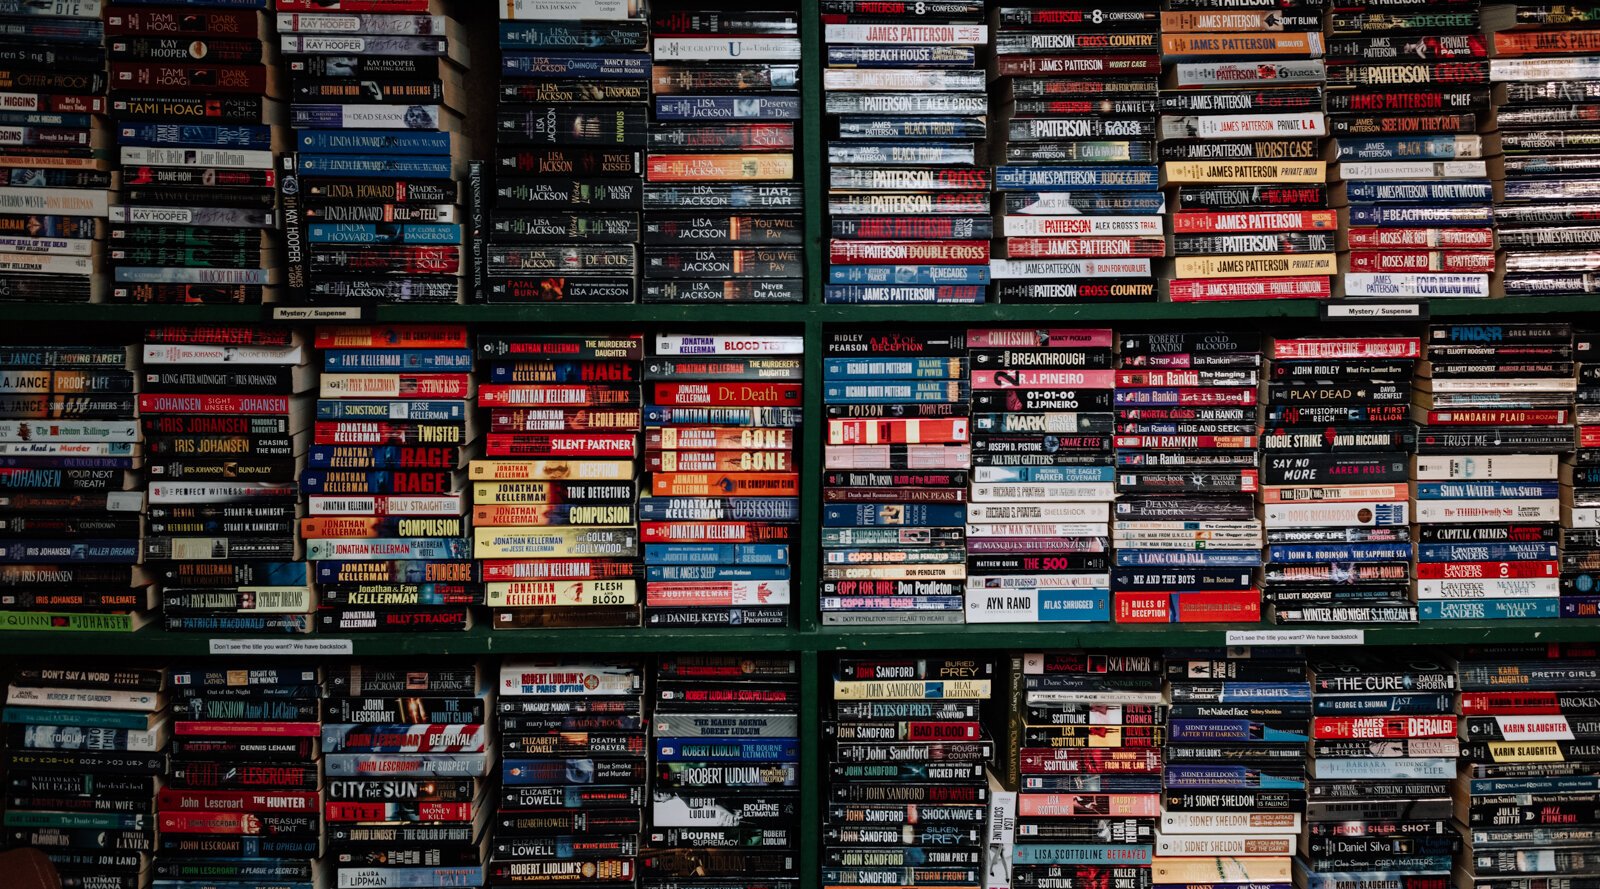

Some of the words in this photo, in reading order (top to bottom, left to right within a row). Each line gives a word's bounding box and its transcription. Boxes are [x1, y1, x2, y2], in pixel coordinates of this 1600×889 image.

[867, 27, 898, 41] JAMES
[900, 27, 954, 41] PATTERSON
[160, 40, 178, 48] KAY
[306, 41, 323, 49] KAY
[326, 41, 360, 50] HOOPER
[1190, 39, 1219, 50] JAMES
[1222, 38, 1276, 49] PATTERSON
[1441, 37, 1469, 48] PRIVATE
[151, 49, 188, 58] HOOPER
[1369, 67, 1430, 83] PATTERSON
[697, 99, 715, 107] LISA
[129, 103, 160, 114] TAMI
[164, 104, 203, 115] HOAG
[692, 106, 731, 117] JACKSON
[616, 111, 624, 142] ENVIOUS
[1256, 142, 1287, 157] WORST
[1289, 142, 1313, 156] CASE
[1207, 167, 1232, 178] JAMES
[1234, 166, 1277, 177] PATTERSON
[1281, 167, 1301, 175] PRIVATE
[1432, 185, 1485, 197] HONEYMOON
[133, 212, 150, 220] KAY
[152, 212, 188, 220] HOOPER
[286, 209, 298, 224] KAY
[327, 233, 374, 241] HOWARD
[287, 227, 301, 263] HOOPER
[862, 288, 889, 301] JAMES
[891, 288, 934, 300] PATTERSON
[1079, 285, 1109, 296] CROSS
[1111, 285, 1153, 296] COUNTRY
[1452, 326, 1502, 341] FINDER
[1012, 352, 1085, 364] BREAKTHROUGH
[1149, 373, 1164, 385] Ian
[1167, 372, 1198, 385] Rankin
[719, 387, 737, 400] Dr.
[741, 387, 778, 400] Death
[155, 398, 201, 410] JOHANSEN
[345, 405, 387, 415] SUNSTROKE
[1454, 413, 1496, 421] MANDARIN
[1501, 413, 1524, 421] PLAID
[418, 426, 459, 442] TWISTED
[552, 439, 585, 450] SILENT
[587, 439, 630, 450] PARTNER
[1444, 436, 1470, 446] TRUST
[1474, 436, 1488, 446] ME
[1274, 459, 1292, 468] SAY
[1296, 459, 1309, 468] NO
[1284, 469, 1317, 480] MORE
[399, 520, 459, 536] COMPULSION
[1438, 530, 1471, 539] CAPITAL
[1473, 529, 1508, 539] CRIMES
[1024, 559, 1039, 569] THE
[1043, 558, 1067, 569] 500
[1133, 575, 1145, 584] ME
[1147, 575, 1160, 584] AND
[1162, 575, 1176, 584] THE
[1178, 575, 1195, 584] BOYS
[593, 595, 624, 603] BLOOD
[987, 597, 1004, 609] AYN
[1008, 597, 1030, 609] RAND
[667, 613, 701, 622] DANIEL
[702, 612, 729, 622] KEYES
[1132, 609, 1165, 617] DECEPTION
[8, 616, 49, 625] QUINN
[42, 670, 64, 679] DON'T
[66, 671, 79, 679] SAY
[87, 672, 109, 681] WORD
[1334, 677, 1363, 690] THE
[1363, 676, 1402, 690] CURE
[363, 699, 384, 710] JOHN
[352, 711, 394, 722] LESCROART
[1352, 719, 1384, 728] JAMES
[1409, 718, 1452, 736] DERAILED
[1528, 724, 1567, 732] SLAUGHTER
[1352, 728, 1384, 738] SIEGEL
[866, 746, 886, 760] John
[889, 746, 929, 759] Sandford
[689, 768, 721, 784] ROBERT
[725, 767, 759, 783] LUDLUM
[929, 769, 952, 778] WICKED
[954, 769, 970, 777] PREY
[330, 782, 365, 797] CITY
[383, 781, 418, 797] SUN
[1195, 795, 1219, 807] SIDNEY
[1220, 795, 1254, 806] SHELDON
[922, 810, 949, 820] SHOCK
[951, 810, 973, 820] WAVE
[1497, 807, 1520, 815] JULIE
[993, 807, 1003, 840] SCOTTOLINE
[1004, 818, 1013, 830] LISA
[1493, 816, 1520, 824] SMITH
[1339, 842, 1367, 852] Daniel
[1370, 841, 1390, 852] Silva
[1113, 869, 1136, 877] KILLER
[1115, 879, 1134, 888] SMILE
